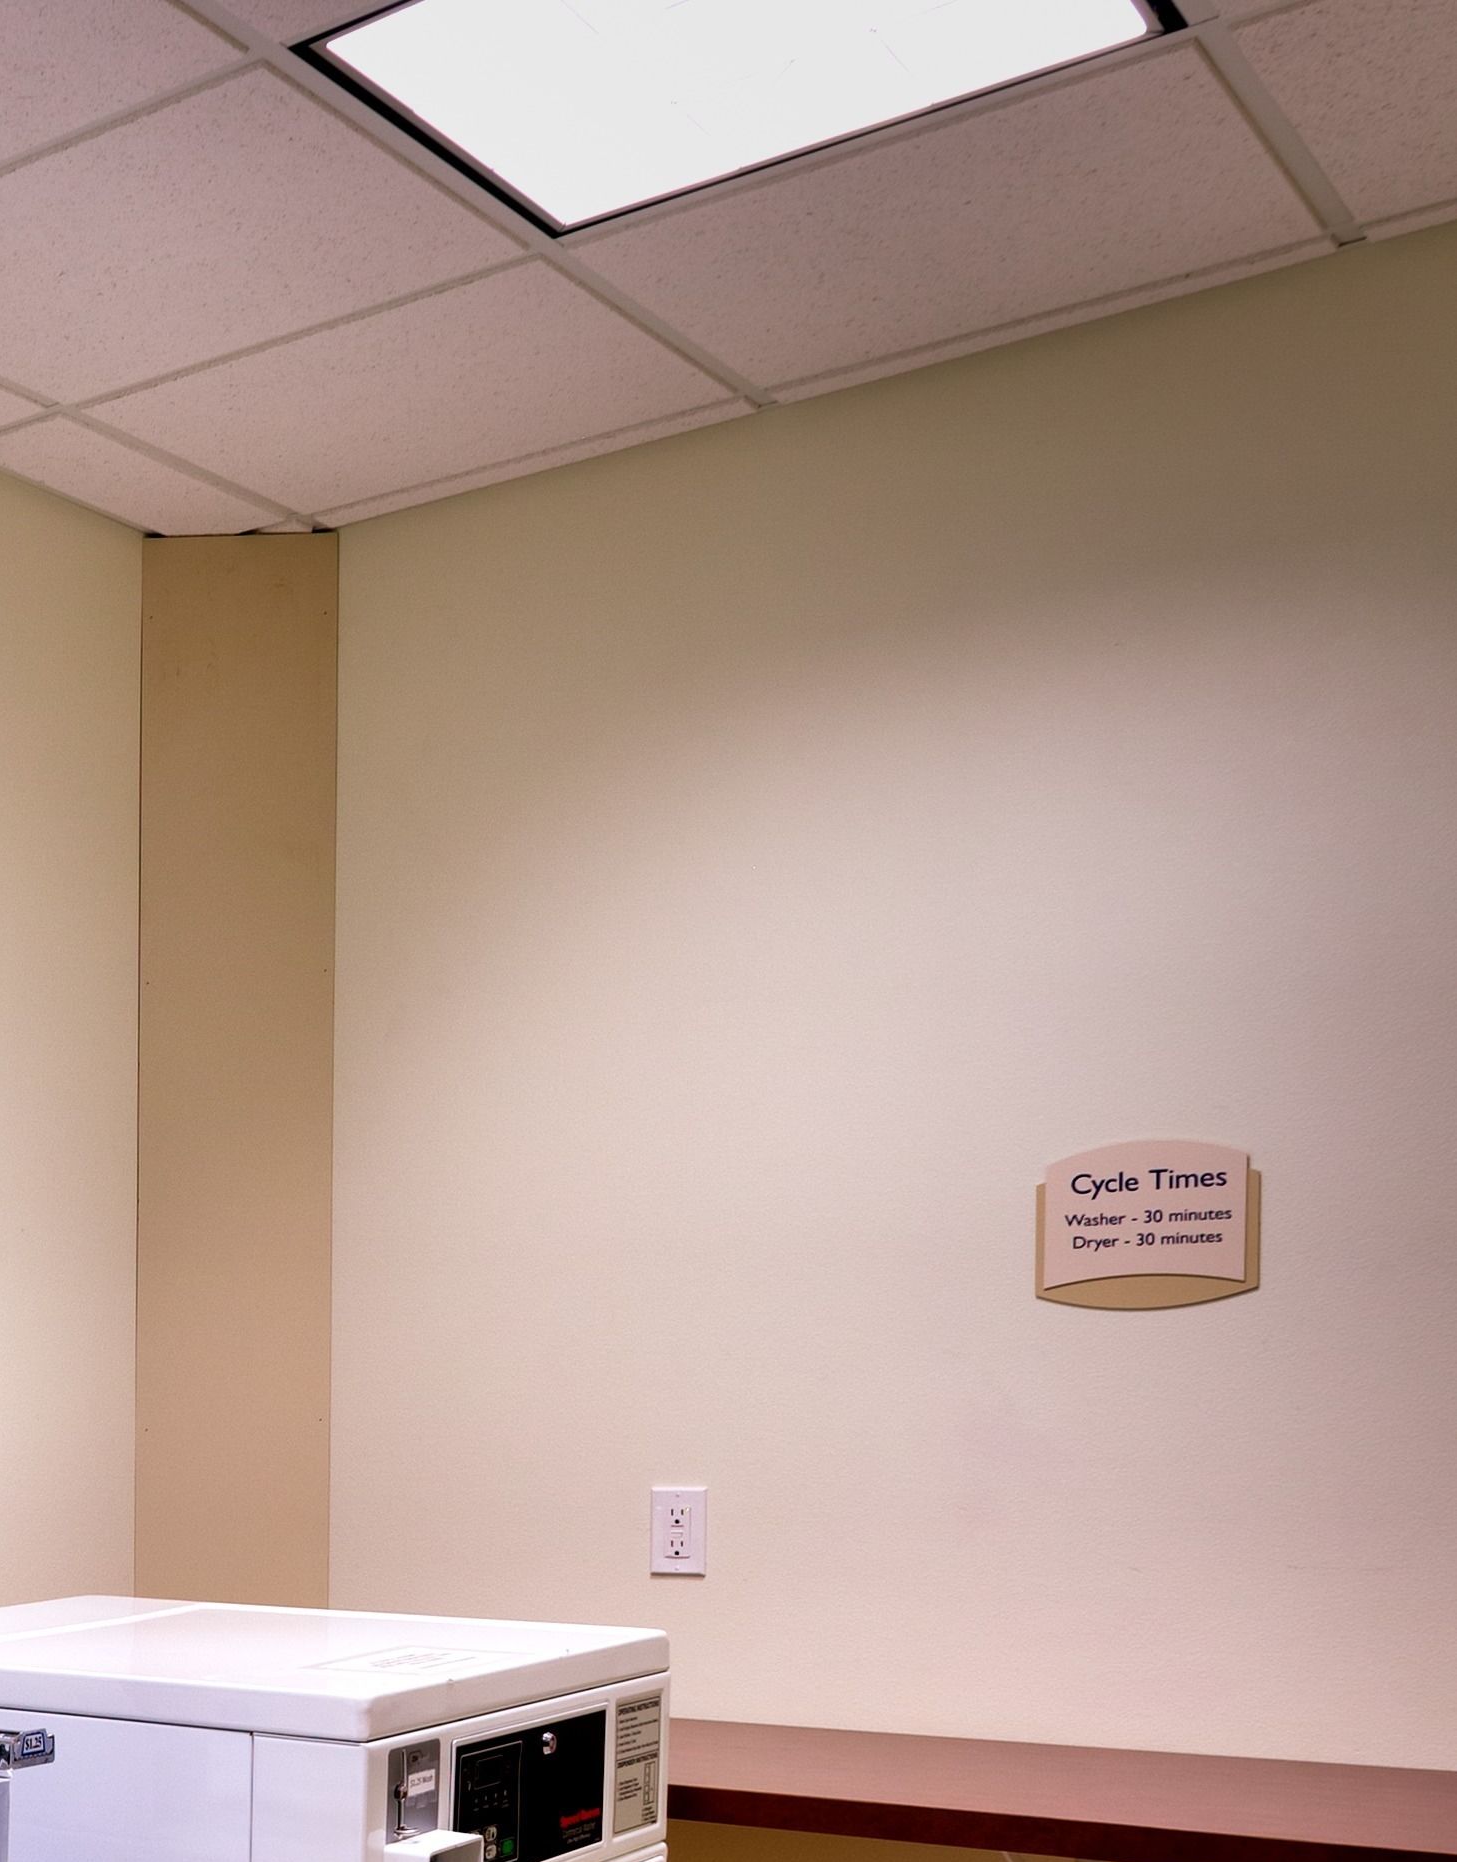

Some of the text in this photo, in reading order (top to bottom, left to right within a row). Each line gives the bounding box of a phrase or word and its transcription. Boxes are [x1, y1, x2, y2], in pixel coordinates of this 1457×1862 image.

[1071, 1169, 1227, 1200] Cycle Times
[1065, 1213, 1126, 1226] Washer
[1143, 1210, 1162, 1223] 30
[1169, 1209, 1232, 1222] minutes
[1073, 1236, 1118, 1251] Dryer
[1136, 1233, 1155, 1246] 30
[1161, 1232, 1222, 1244] minutes
